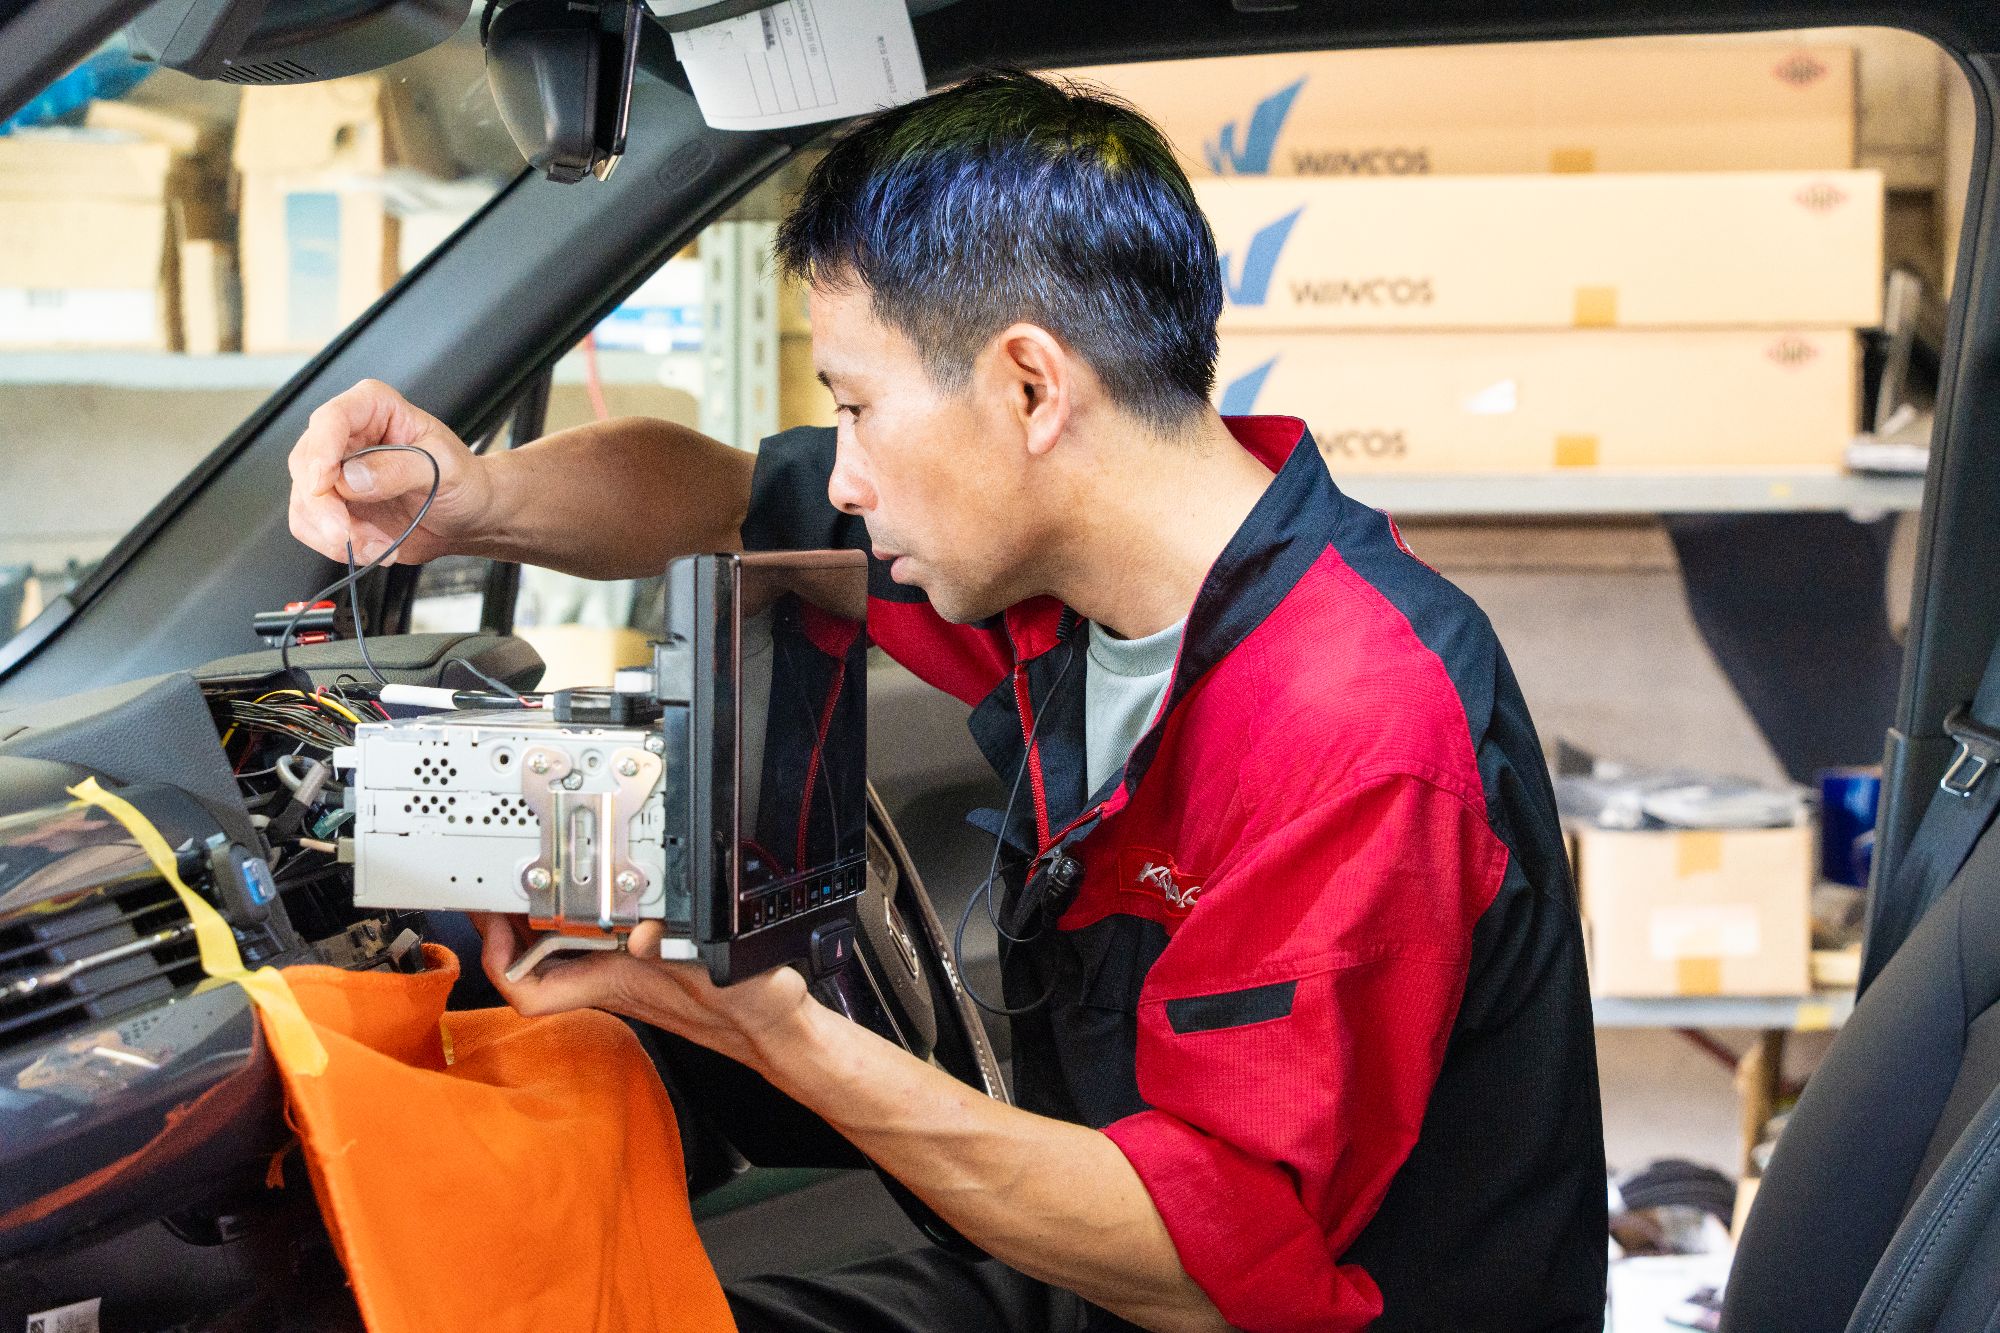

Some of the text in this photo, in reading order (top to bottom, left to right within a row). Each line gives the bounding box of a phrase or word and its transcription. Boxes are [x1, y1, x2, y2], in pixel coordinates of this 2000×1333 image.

[1291, 148, 1430, 174] WINCOS
[1289, 278, 1434, 306] WINCOS
[1315, 429, 1407, 458] NCOS
